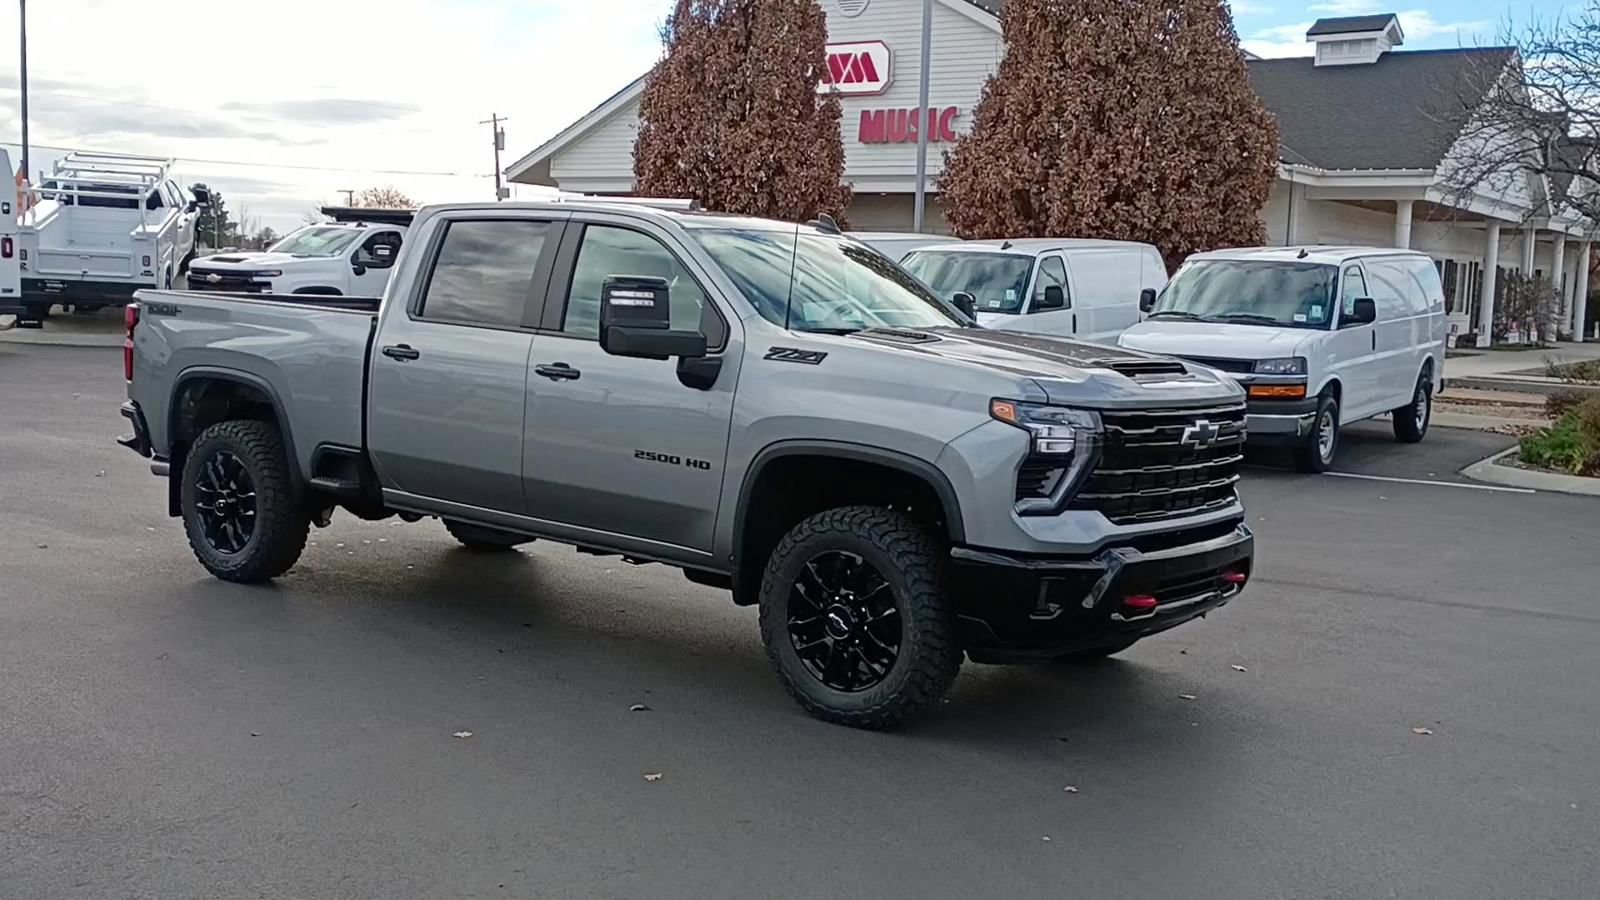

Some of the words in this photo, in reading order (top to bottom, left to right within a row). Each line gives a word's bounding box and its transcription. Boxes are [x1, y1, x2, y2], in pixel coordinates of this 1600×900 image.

[858, 106, 960, 144] MUSIC
[634, 449, 681, 465] 2500
[685, 458, 711, 470] HD
